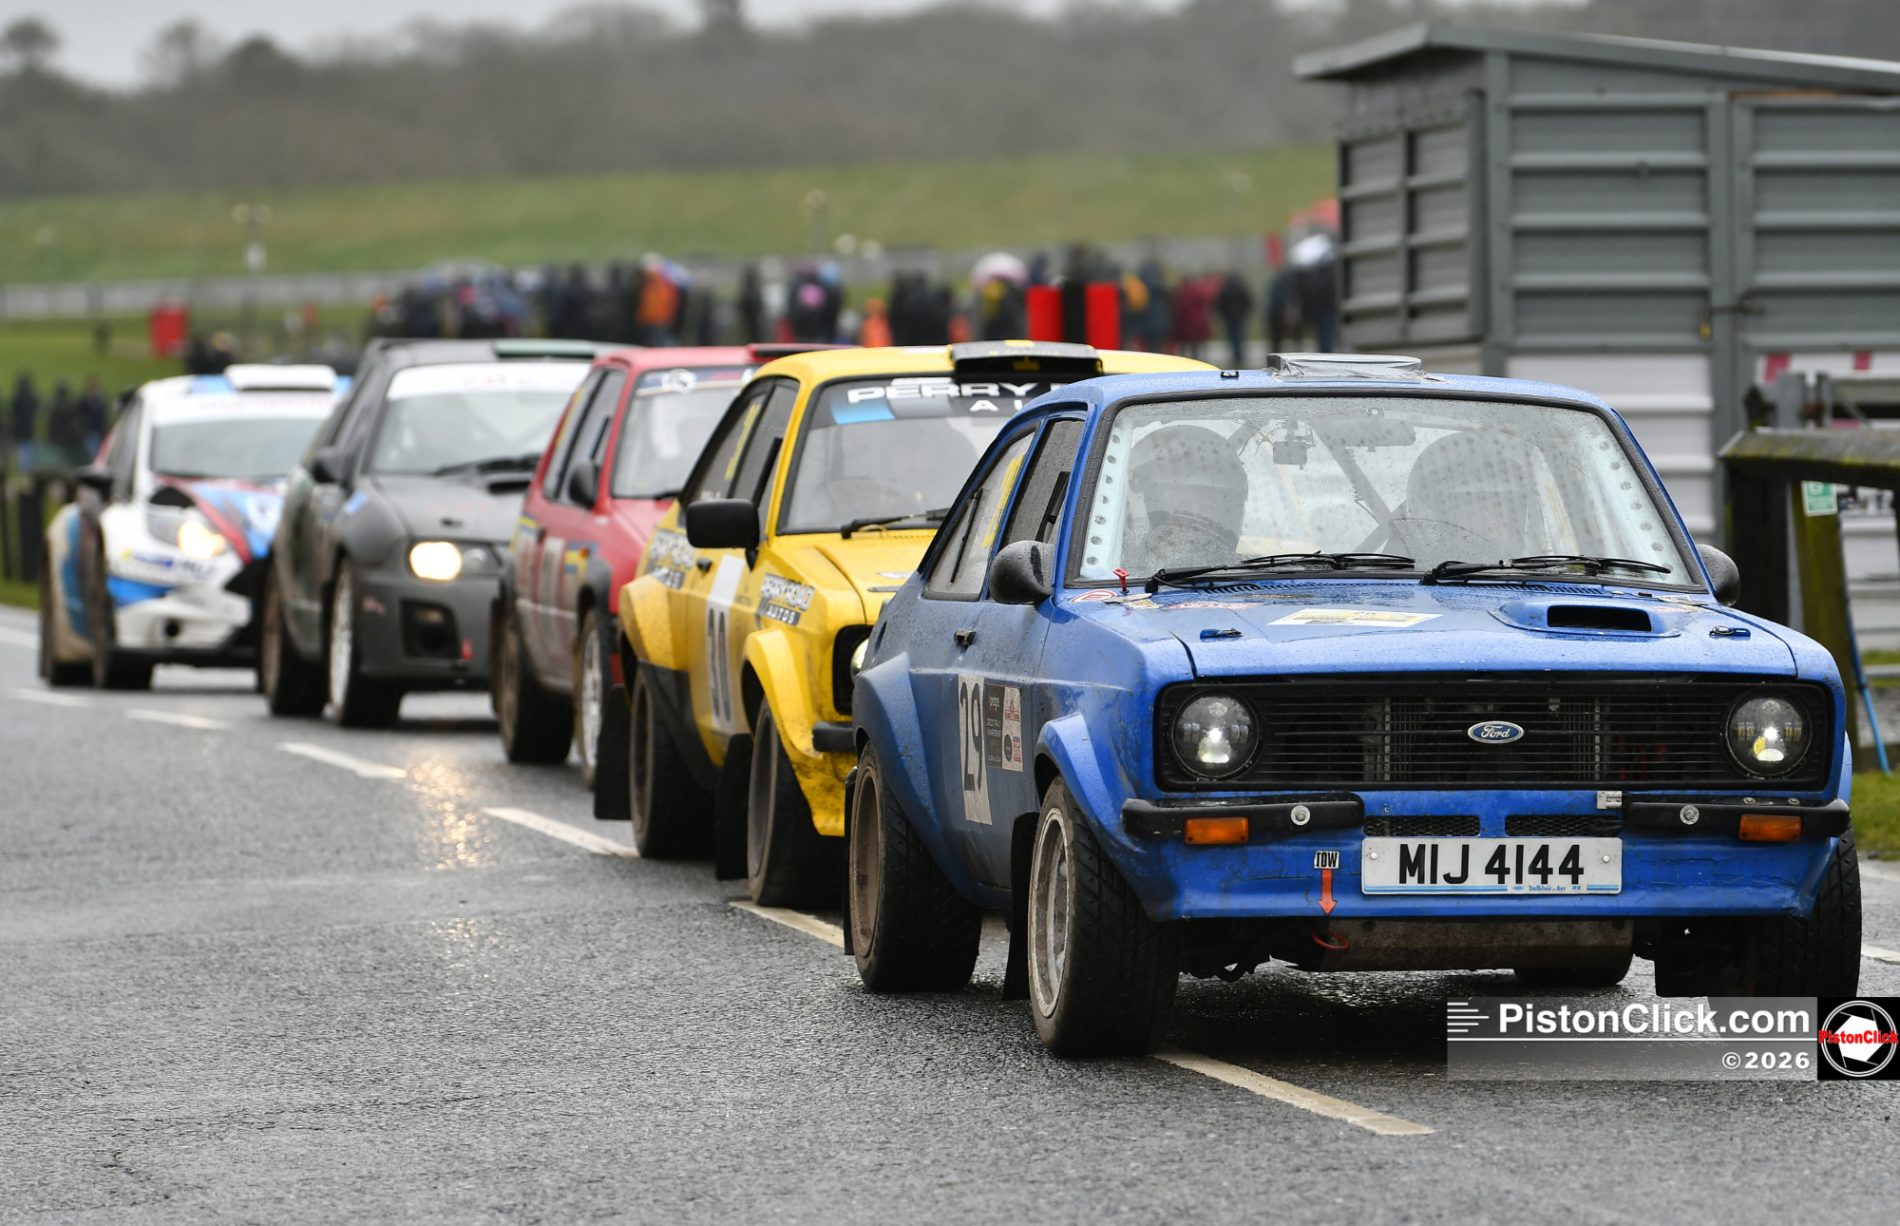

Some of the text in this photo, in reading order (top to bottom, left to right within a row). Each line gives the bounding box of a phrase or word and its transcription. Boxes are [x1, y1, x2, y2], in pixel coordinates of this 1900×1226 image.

[848, 382, 1039, 403] PERRY
[765, 603, 797, 625] AUTOS
[960, 681, 983, 791] 29
[1480, 725, 1511, 738] Ford
[1315, 852, 1338, 868] TOW
[1399, 843, 1585, 885] MIJ 4144
